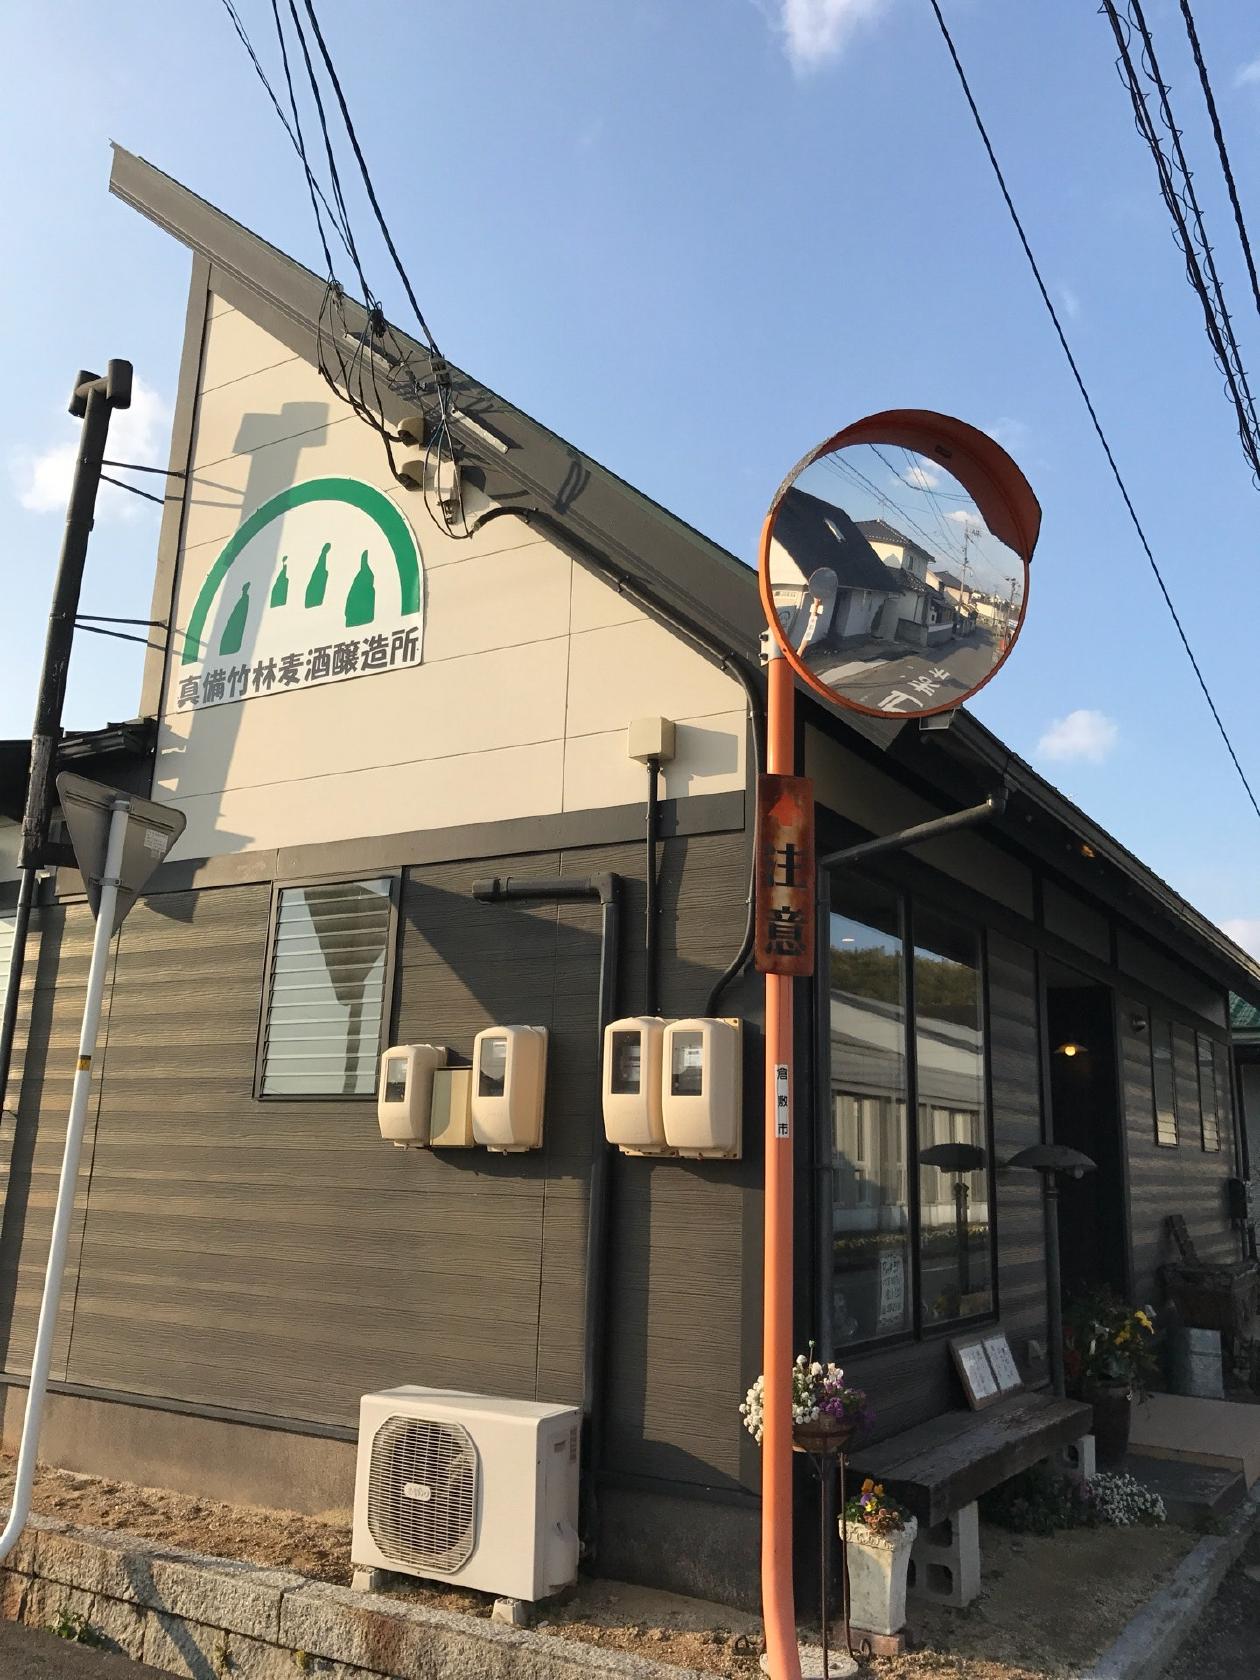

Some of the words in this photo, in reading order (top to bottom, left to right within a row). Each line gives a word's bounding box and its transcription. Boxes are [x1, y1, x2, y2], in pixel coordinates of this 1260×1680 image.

[177, 626, 419, 708] 真備竹林麦酒醸造所
[777, 1067, 788, 1135] 倉敷市
